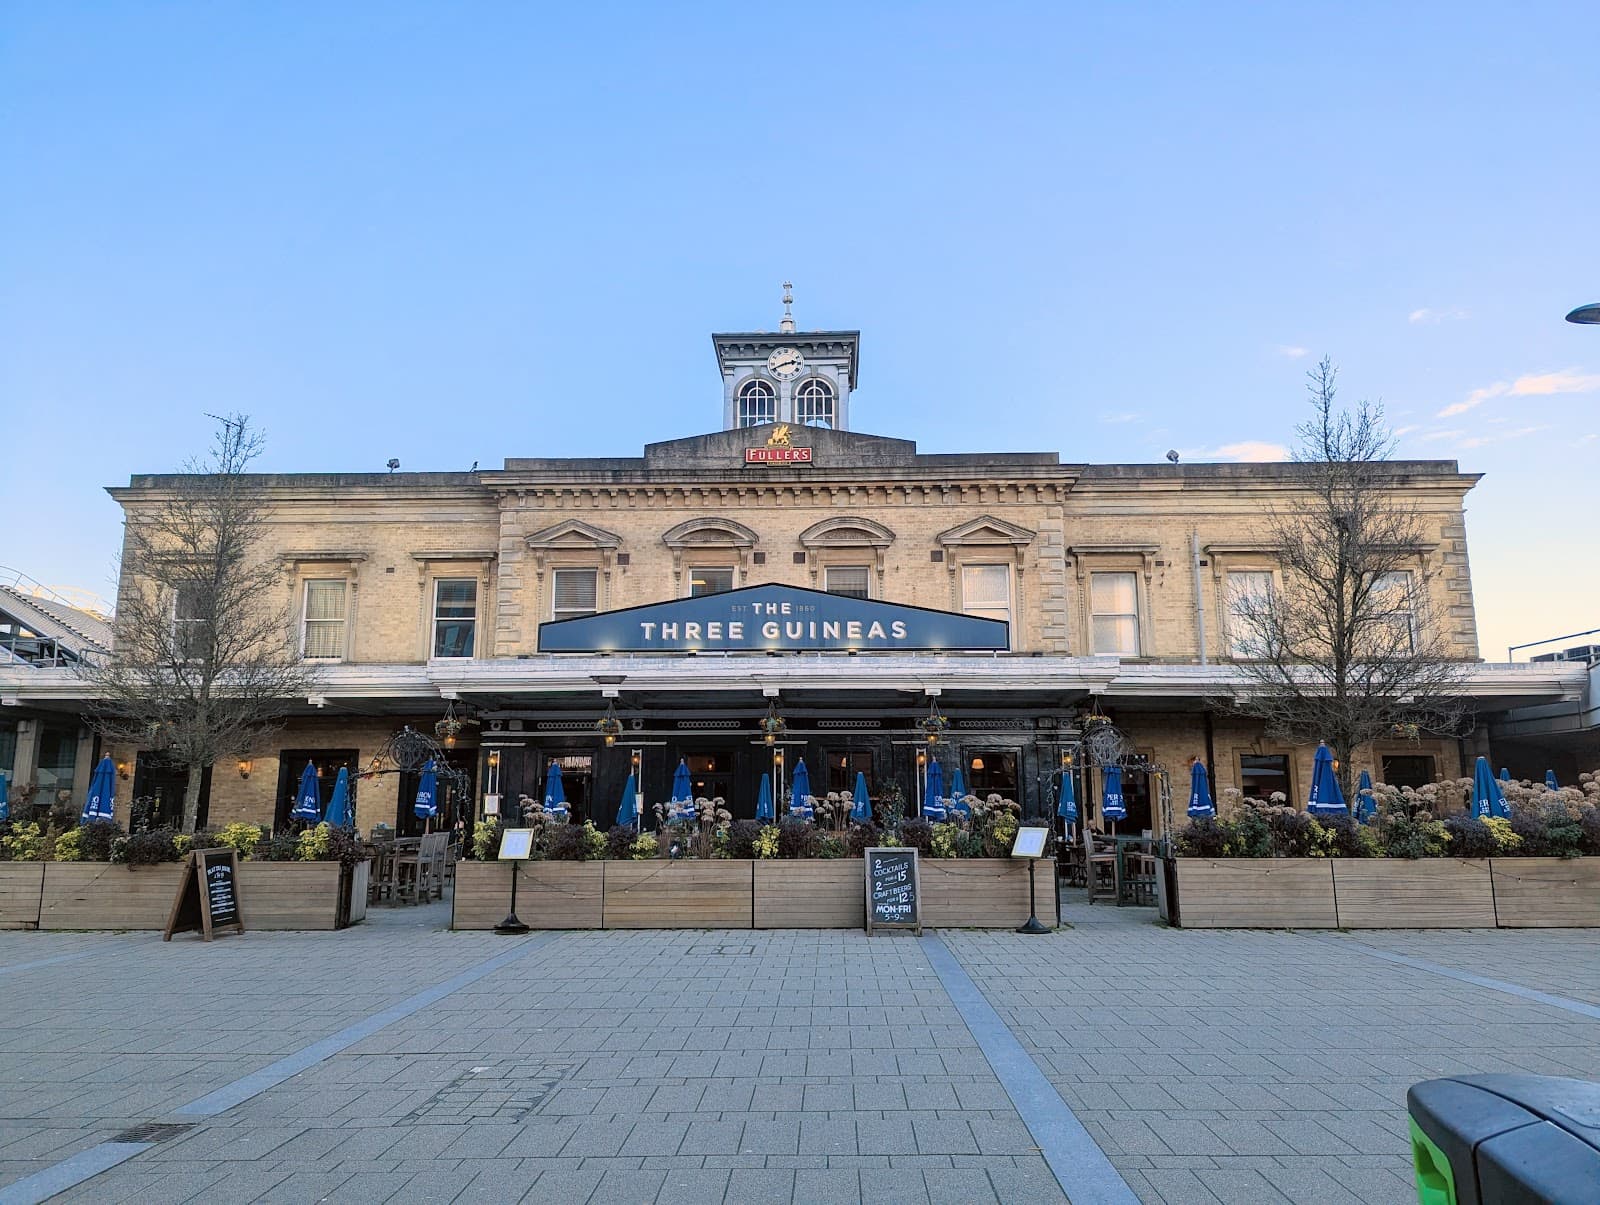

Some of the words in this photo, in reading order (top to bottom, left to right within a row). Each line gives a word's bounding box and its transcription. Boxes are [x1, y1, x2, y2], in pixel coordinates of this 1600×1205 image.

[752, 602, 791, 615] THE
[640, 621, 744, 640] THREE
[761, 621, 908, 640] GUINEAS
[873, 862, 909, 877] COCKTAILS
[875, 859, 882, 869] 2
[873, 888, 892, 900] CRAFT
[893, 884, 912, 895] BEERS
[875, 881, 883, 891] 2
[876, 904, 911, 913] MON-FRI
